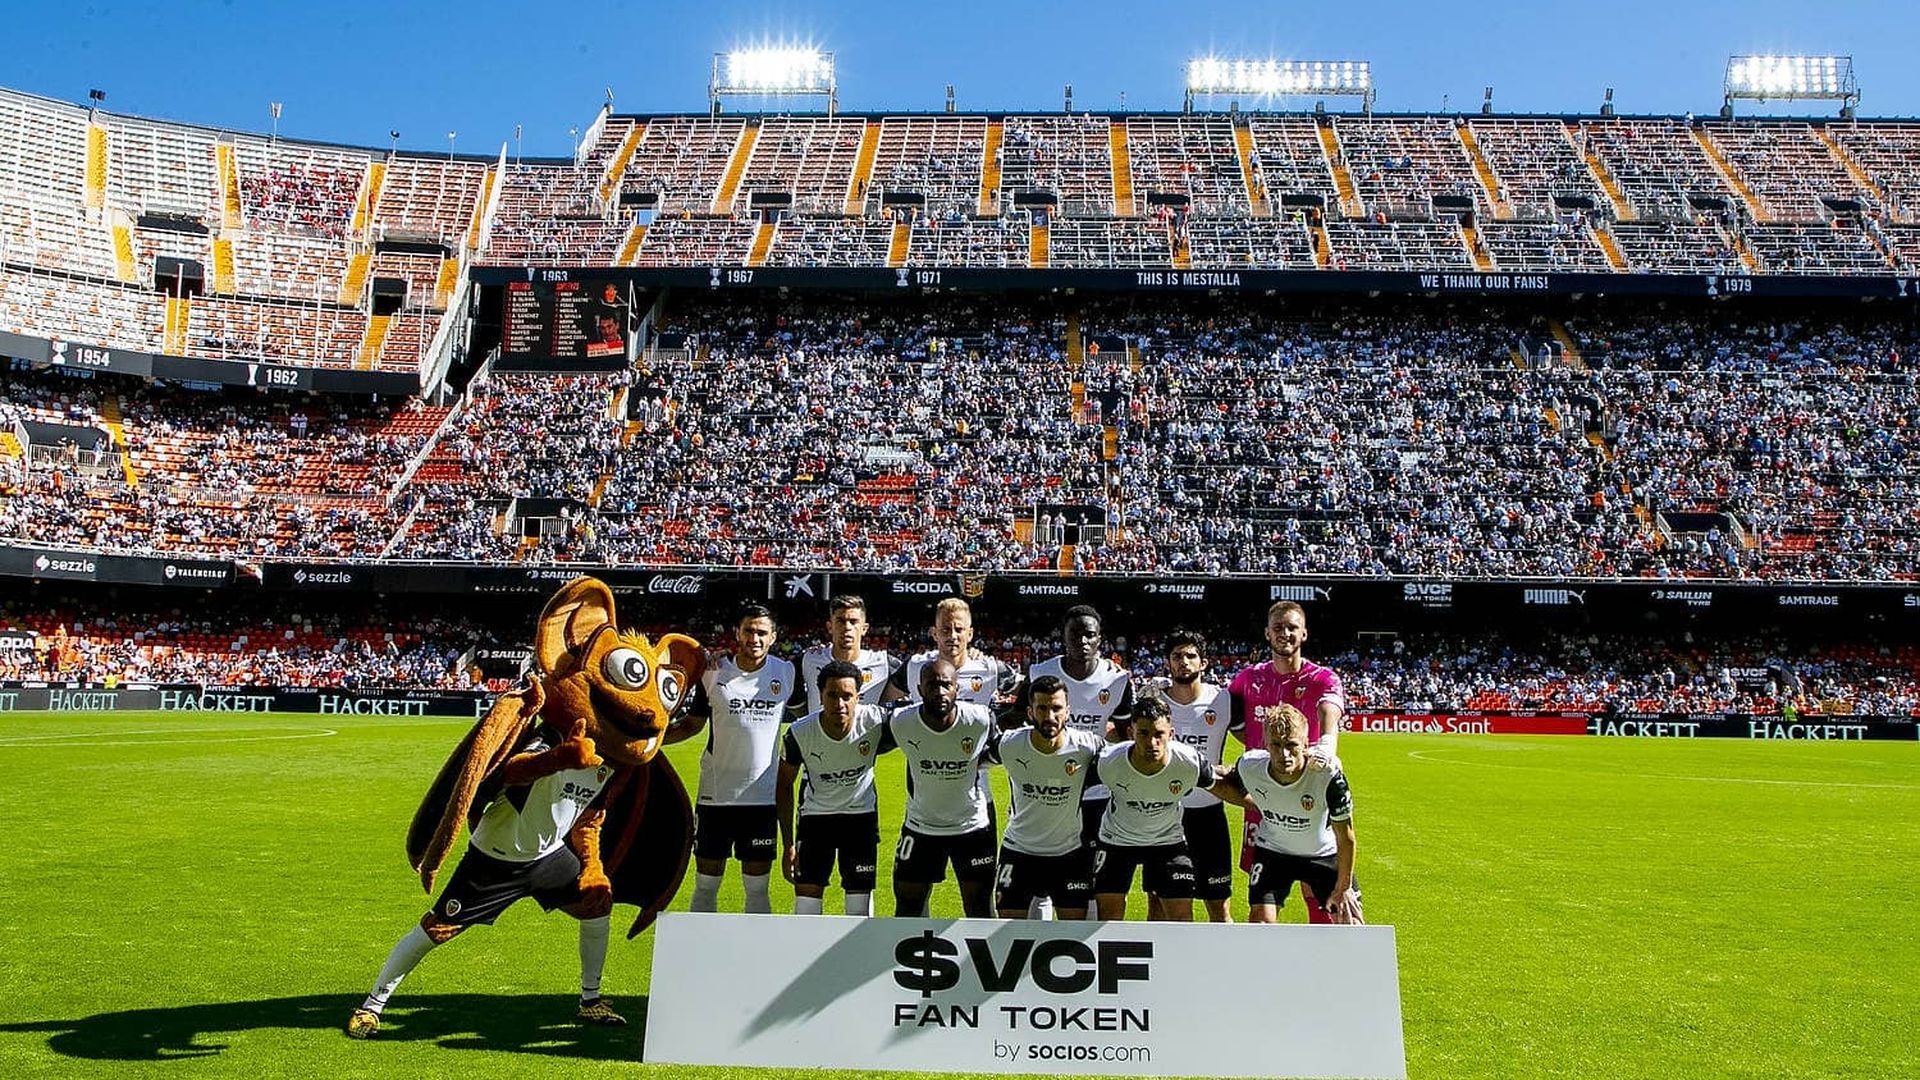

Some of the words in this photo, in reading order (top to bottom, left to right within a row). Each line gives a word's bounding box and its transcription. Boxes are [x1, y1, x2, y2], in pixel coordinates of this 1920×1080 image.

[542, 270, 568, 281] 1963
[727, 270, 754, 284] 1967
[915, 270, 941, 284] 1971
[1136, 272, 1163, 286] THIS
[1166, 272, 1179, 286] IS
[1183, 272, 1240, 286] MESTALLA
[1420, 275, 1440, 288] WE
[1443, 275, 1482, 288] THANK
[1485, 275, 1510, 289] OUR
[1514, 275, 1549, 290] FANS!
[1723, 279, 1752, 293] 1979
[75, 347, 111, 367] 1954
[264, 367, 299, 385] 1962
[50, 559, 96, 573] sezzle
[308, 571, 352, 584] sezzle
[540, 571, 584, 579] SAILUN
[892, 580, 954, 593] ŠKODA
[1018, 585, 1079, 595] SAMTRADE
[1159, 584, 1205, 593] SAILUN
[1270, 585, 1316, 601] PUMA
[1524, 589, 1570, 605] PUMA
[1666, 591, 1713, 600] SAILUN
[1779, 595, 1839, 605] SAMTRADE
[49, 689, 119, 711] HACKETT
[159, 690, 276, 712] HACKETT
[319, 694, 430, 716] HACKETT
[1065, 714, 1102, 725] VCF
[1362, 716, 1424, 733] LaLiga
[1447, 717, 1492, 734] Sant
[1587, 718, 1700, 737] HACKETT
[1749, 721, 1868, 741] HACKETT
[1172, 735, 1209, 745] VCF
[893, 930, 1154, 998] $VCF
[894, 1004, 979, 1028] FAN
[1000, 1007, 1150, 1032] TOKEN
[994, 1039, 1021, 1061] by
